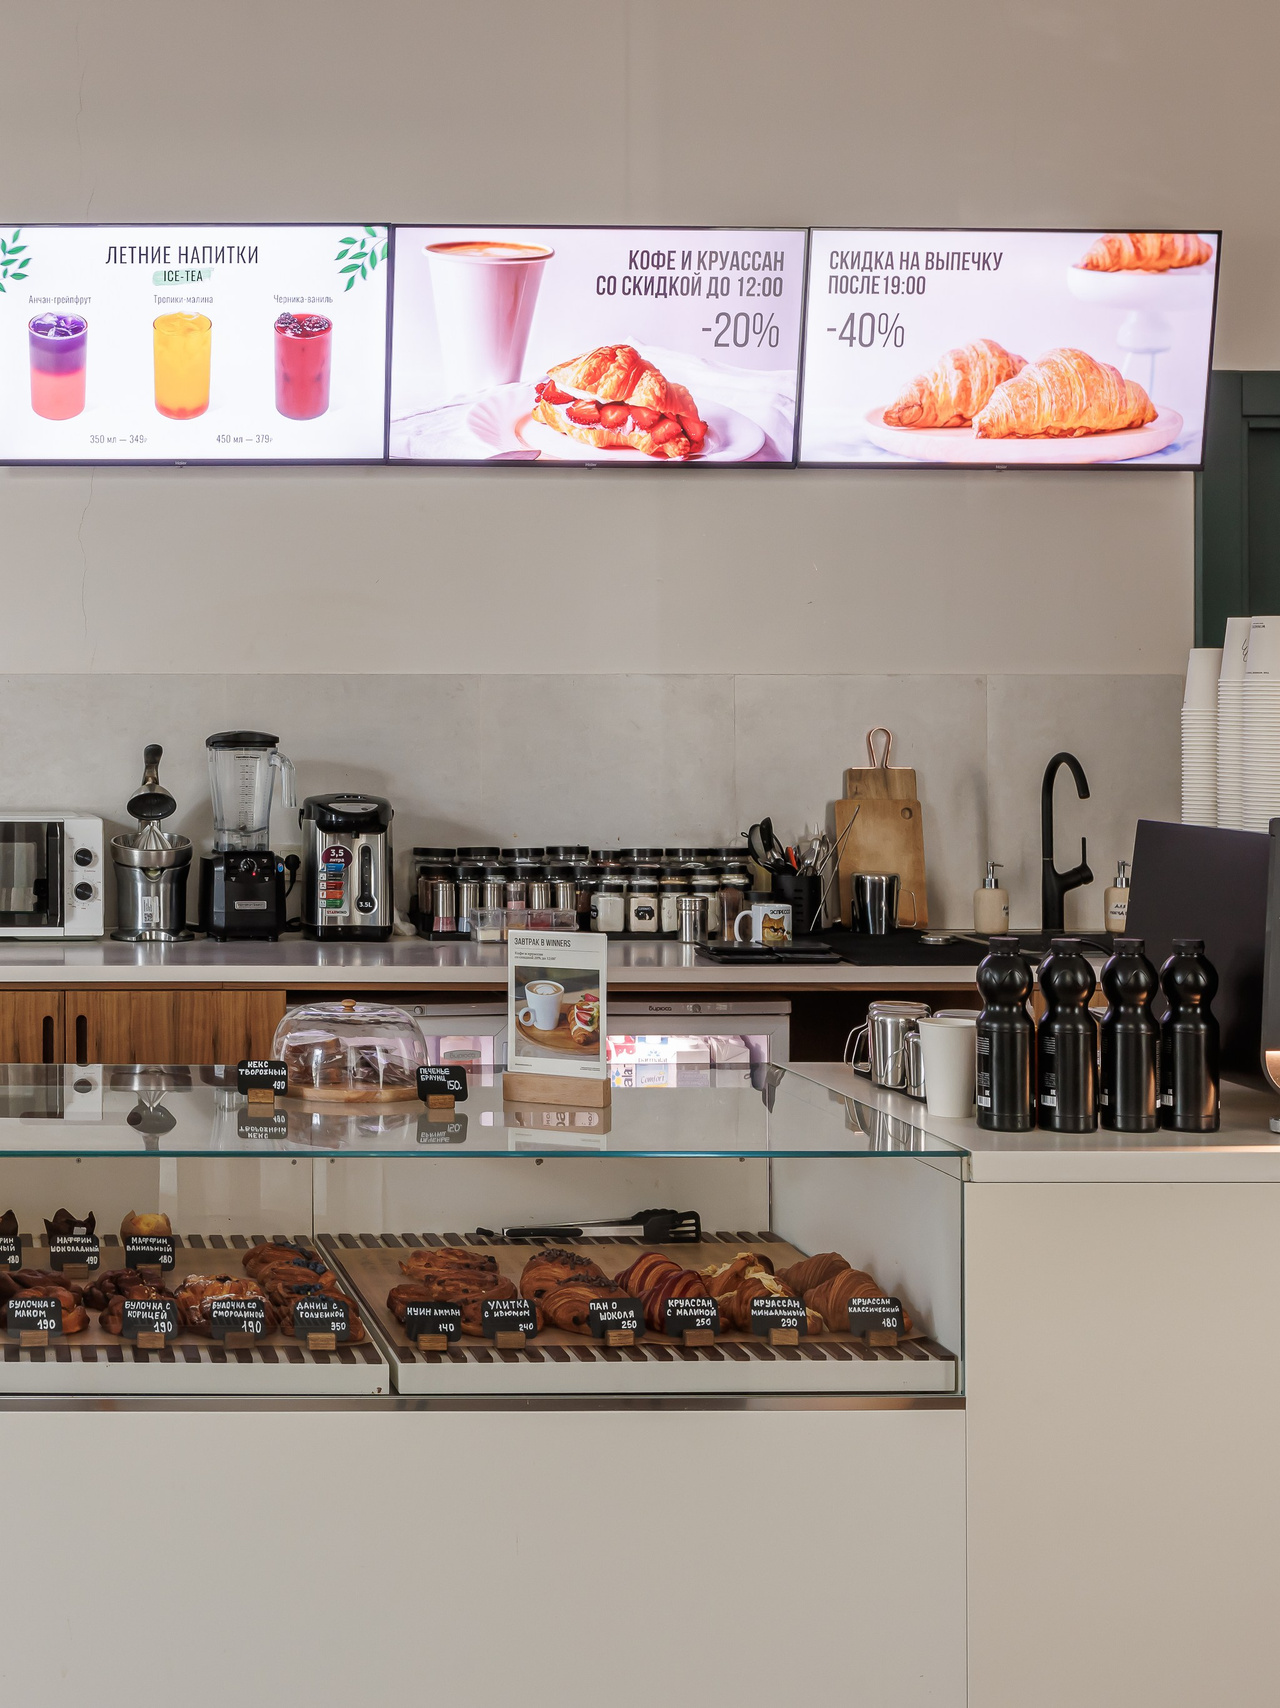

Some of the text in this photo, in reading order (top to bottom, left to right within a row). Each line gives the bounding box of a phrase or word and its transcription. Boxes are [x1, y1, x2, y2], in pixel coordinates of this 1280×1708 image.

[105, 245, 259, 265] ЛЕТНИЕ НАПИТКИ
[628, 249, 785, 272] КОФЕ И КРУАССАН
[829, 250, 1004, 273] СКИДКА НА ВЫПЕЧКУ
[163, 269, 203, 282] ICE-TEA
[595, 272, 783, 299] СО СКИДКОЙ ДО 12:00
[827, 275, 927, 295] ПОСЛЕ 19:00
[28, 294, 92, 306] Анчан-грейпфрут
[153, 294, 214, 305] Тропики-малина
[273, 294, 334, 304] Черника-ваниль
[701, 312, 780, 348] -20%
[826, 312, 905, 348] -40%
[89, 434, 105, 444] 350
[216, 434, 231, 444] 450
[330, 849, 344, 858] 3,5
[514, 937, 572, 948] ЗАВТРАК В WINNERS
[238, 1067, 287, 1076] ТВОРОЖНЫЙ
[419, 1067, 450, 1075] ПЕЧЕНЬЕ
[272, 1080, 286, 1090] 190
[56, 1236, 92, 1244] МАФФИН
[131, 1237, 168, 1245] МАФФИН
[50, 1245, 100, 1253] ШОКОЛАДНЫЙ
[126, 1244, 173, 1253] ВАНИЛЬНЫЙ
[7, 1255, 20, 1264] 180
[86, 1255, 98, 1265] 190
[158, 1254, 173, 1264] 180
[8, 1300, 49, 1310] БУЛОЧКА
[124, 1301, 164, 1311] БУЛОЧКА
[212, 1301, 246, 1310] БУЛОЧКА
[296, 1302, 328, 1312] ДАНИШ
[487, 1300, 530, 1310] УЛИТКА
[589, 1302, 618, 1311] ПАН О
[668, 1299, 713, 1308] КРУАССАН
[753, 1298, 800, 1308] КРУАССАН
[852, 1298, 891, 1306] КРУАССАН
[14, 1309, 46, 1318] МАКОМ
[127, 1309, 168, 1320] КОРИЦЕЙ
[212, 1309, 265, 1319] СМОРОДИНОЙ
[299, 1309, 345, 1319] ГОЛУБИКОЙ
[433, 1309, 461, 1317] АММАН
[599, 1310, 635, 1321] ШОКОЛЯ
[676, 1307, 717, 1317] МАЛИНОЙ
[751, 1307, 806, 1317] МИНДАЛЬНЫЙ
[37, 1319, 56, 1330] 190
[153, 1321, 173, 1333] 190
[241, 1320, 262, 1334] 190
[330, 1322, 346, 1331] 350
[438, 1323, 455, 1332] 140
[518, 1322, 534, 1332] 240
[621, 1320, 637, 1330] 250
[695, 1318, 712, 1327] 250
[781, 1318, 798, 1328] 290
[881, 1317, 898, 1328] 180
